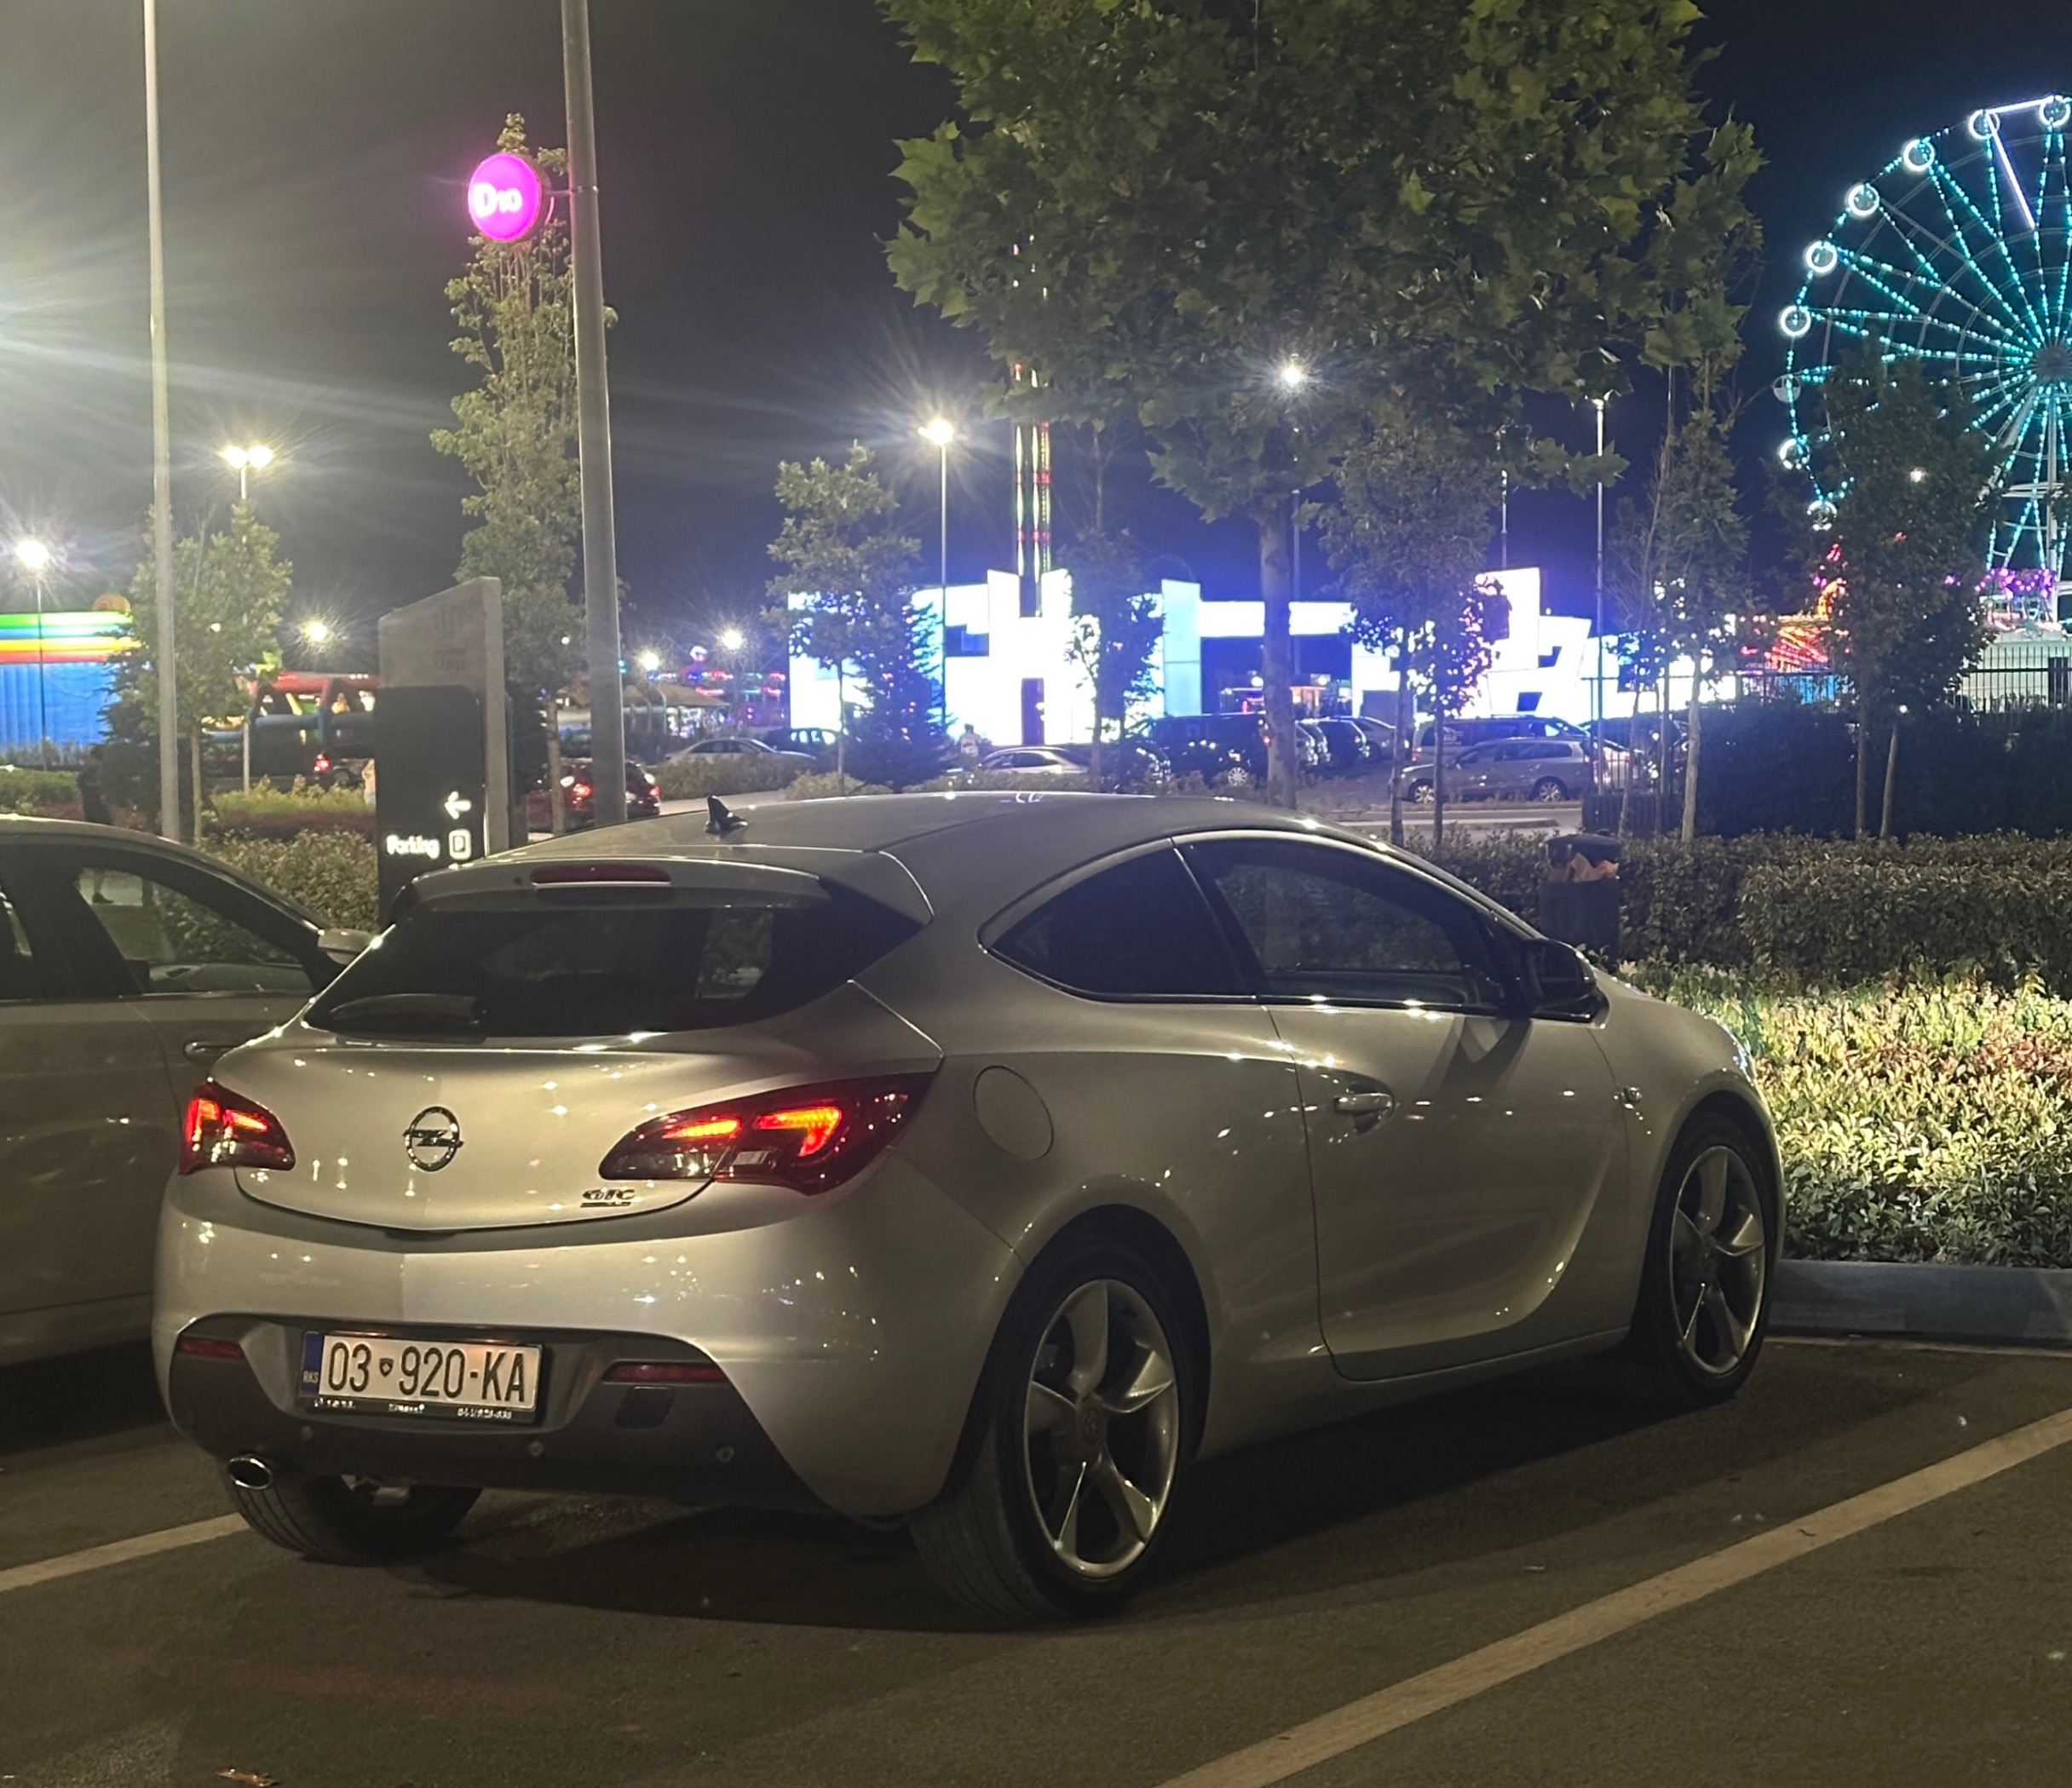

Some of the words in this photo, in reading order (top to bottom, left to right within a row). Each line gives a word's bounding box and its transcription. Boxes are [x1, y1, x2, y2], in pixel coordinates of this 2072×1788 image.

[386, 834, 440, 859] Parking
[302, 1370, 319, 1383] RKS
[328, 1342, 371, 1392] 03
